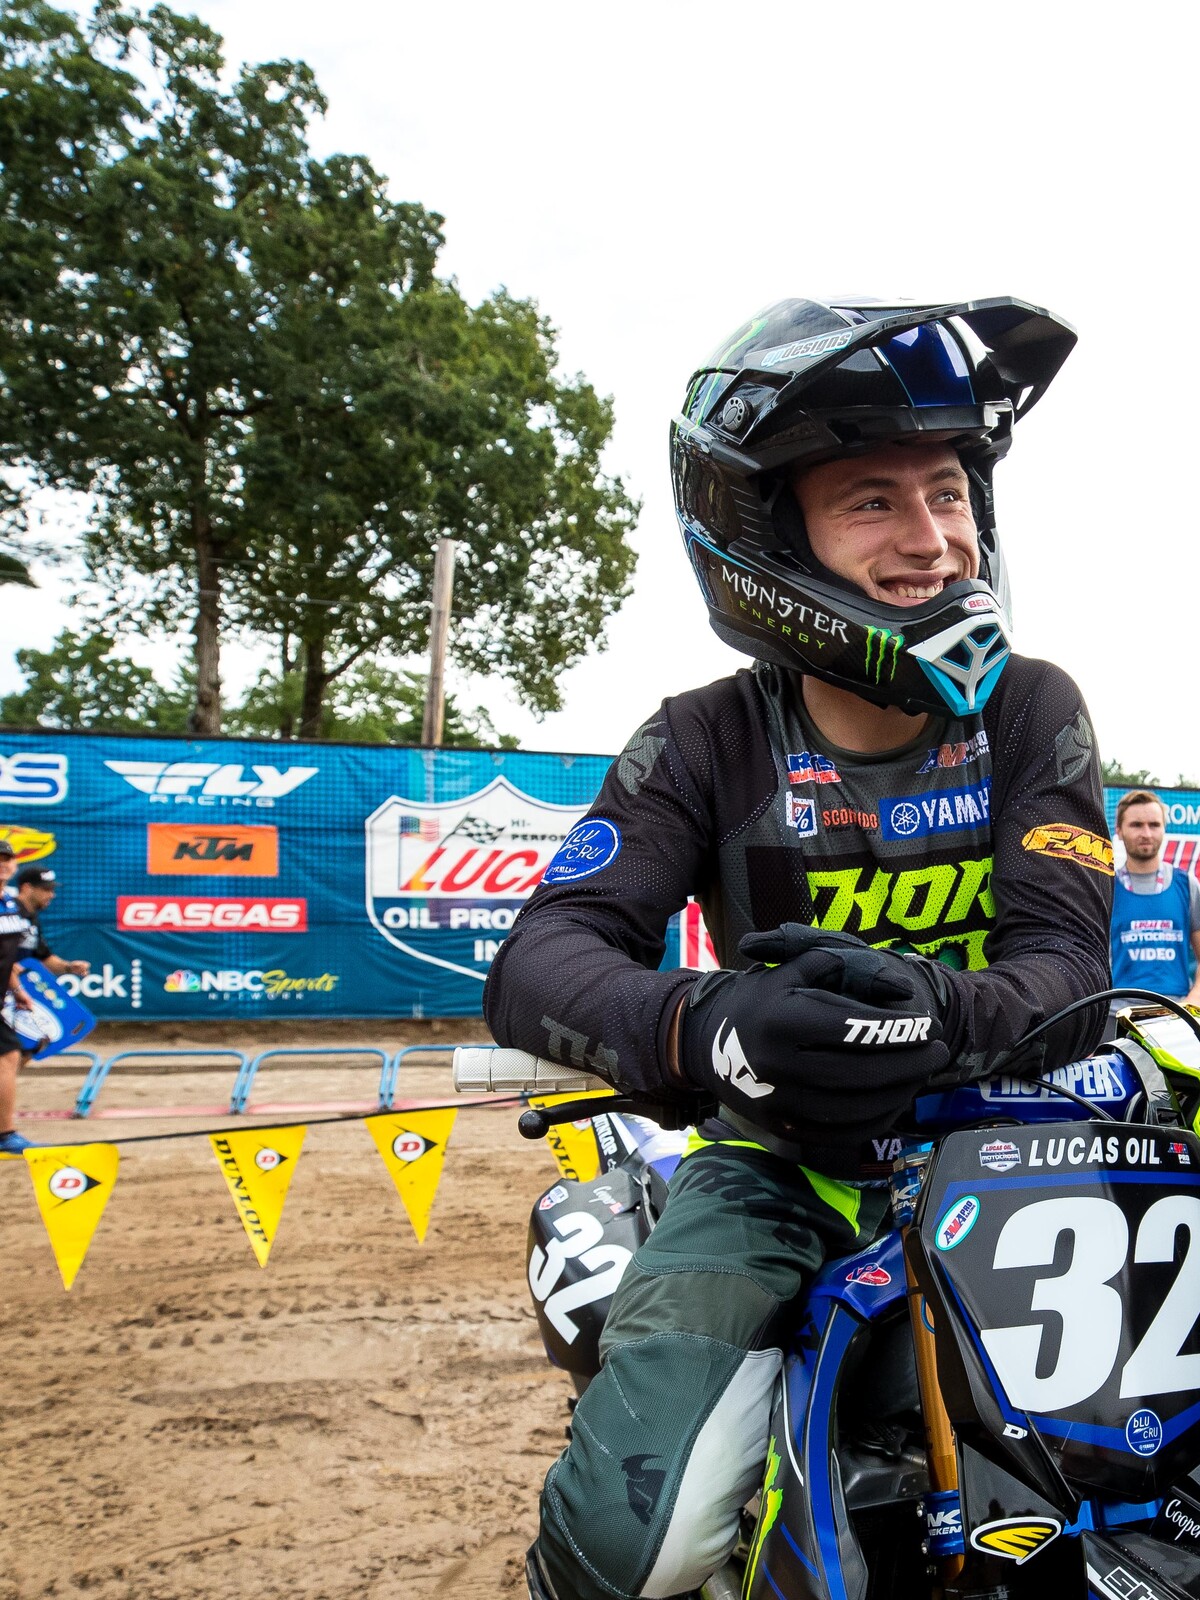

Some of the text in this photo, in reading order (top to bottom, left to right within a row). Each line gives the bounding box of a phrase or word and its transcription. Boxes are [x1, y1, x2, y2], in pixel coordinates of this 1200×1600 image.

[721, 564, 850, 645] MONSTER
[967, 598, 992, 609] BELL
[739, 600, 827, 650] ENERGY
[149, 794, 276, 807] RACING
[172, 836, 253, 861] KTM
[122, 902, 301, 929] GASGAS
[383, 907, 522, 930] OIL PRO
[1128, 947, 1176, 961] VIDEO
[56, 964, 126, 998] ock
[201, 969, 339, 994] NBC Sports
[843, 1014, 932, 1045] THOR
[1028, 1136, 1161, 1168] LUCAS OIL
[215, 1138, 268, 1244] DUNLOP
[959, 1200, 973, 1216] PRO
[528, 1211, 634, 1345] 32
